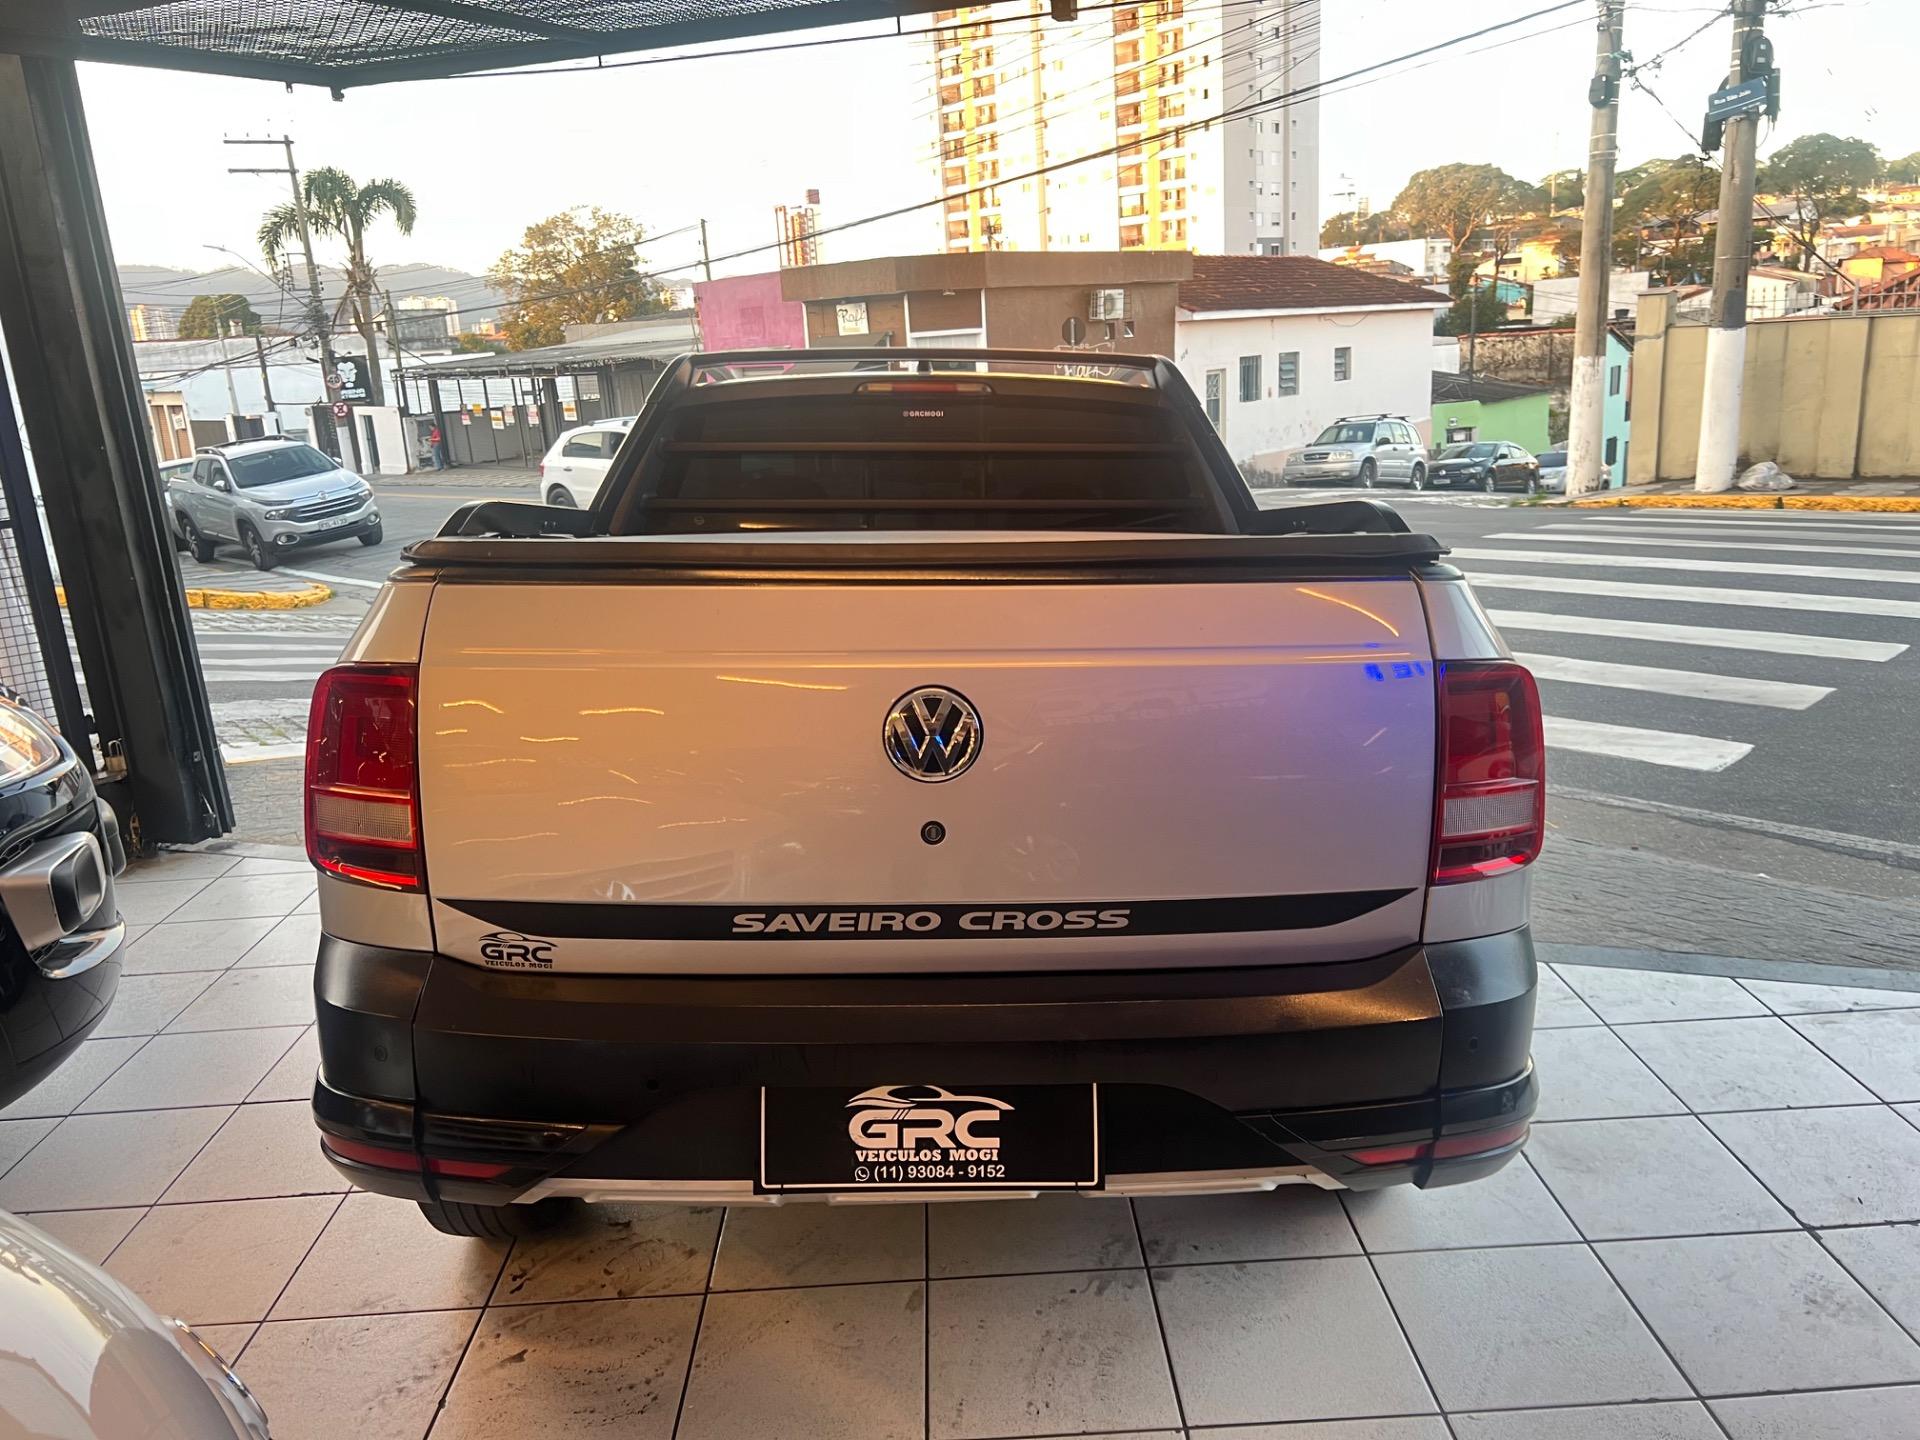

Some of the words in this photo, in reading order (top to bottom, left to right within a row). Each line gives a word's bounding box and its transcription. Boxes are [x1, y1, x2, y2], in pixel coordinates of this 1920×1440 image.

[731, 911, 942, 933] SAVEIRO
[958, 909, 1131, 930] CROSS
[480, 942, 554, 964] GRC
[485, 959, 526, 968] VEICULOS
[848, 1108, 1001, 1149] GRC
[855, 1149, 942, 1162] VEICULOS
[949, 1149, 999, 1161] MOGI
[874, 1165, 904, 1182] (11)
[907, 1165, 955, 1179] 93084
[967, 1164, 1006, 1178] 9152
